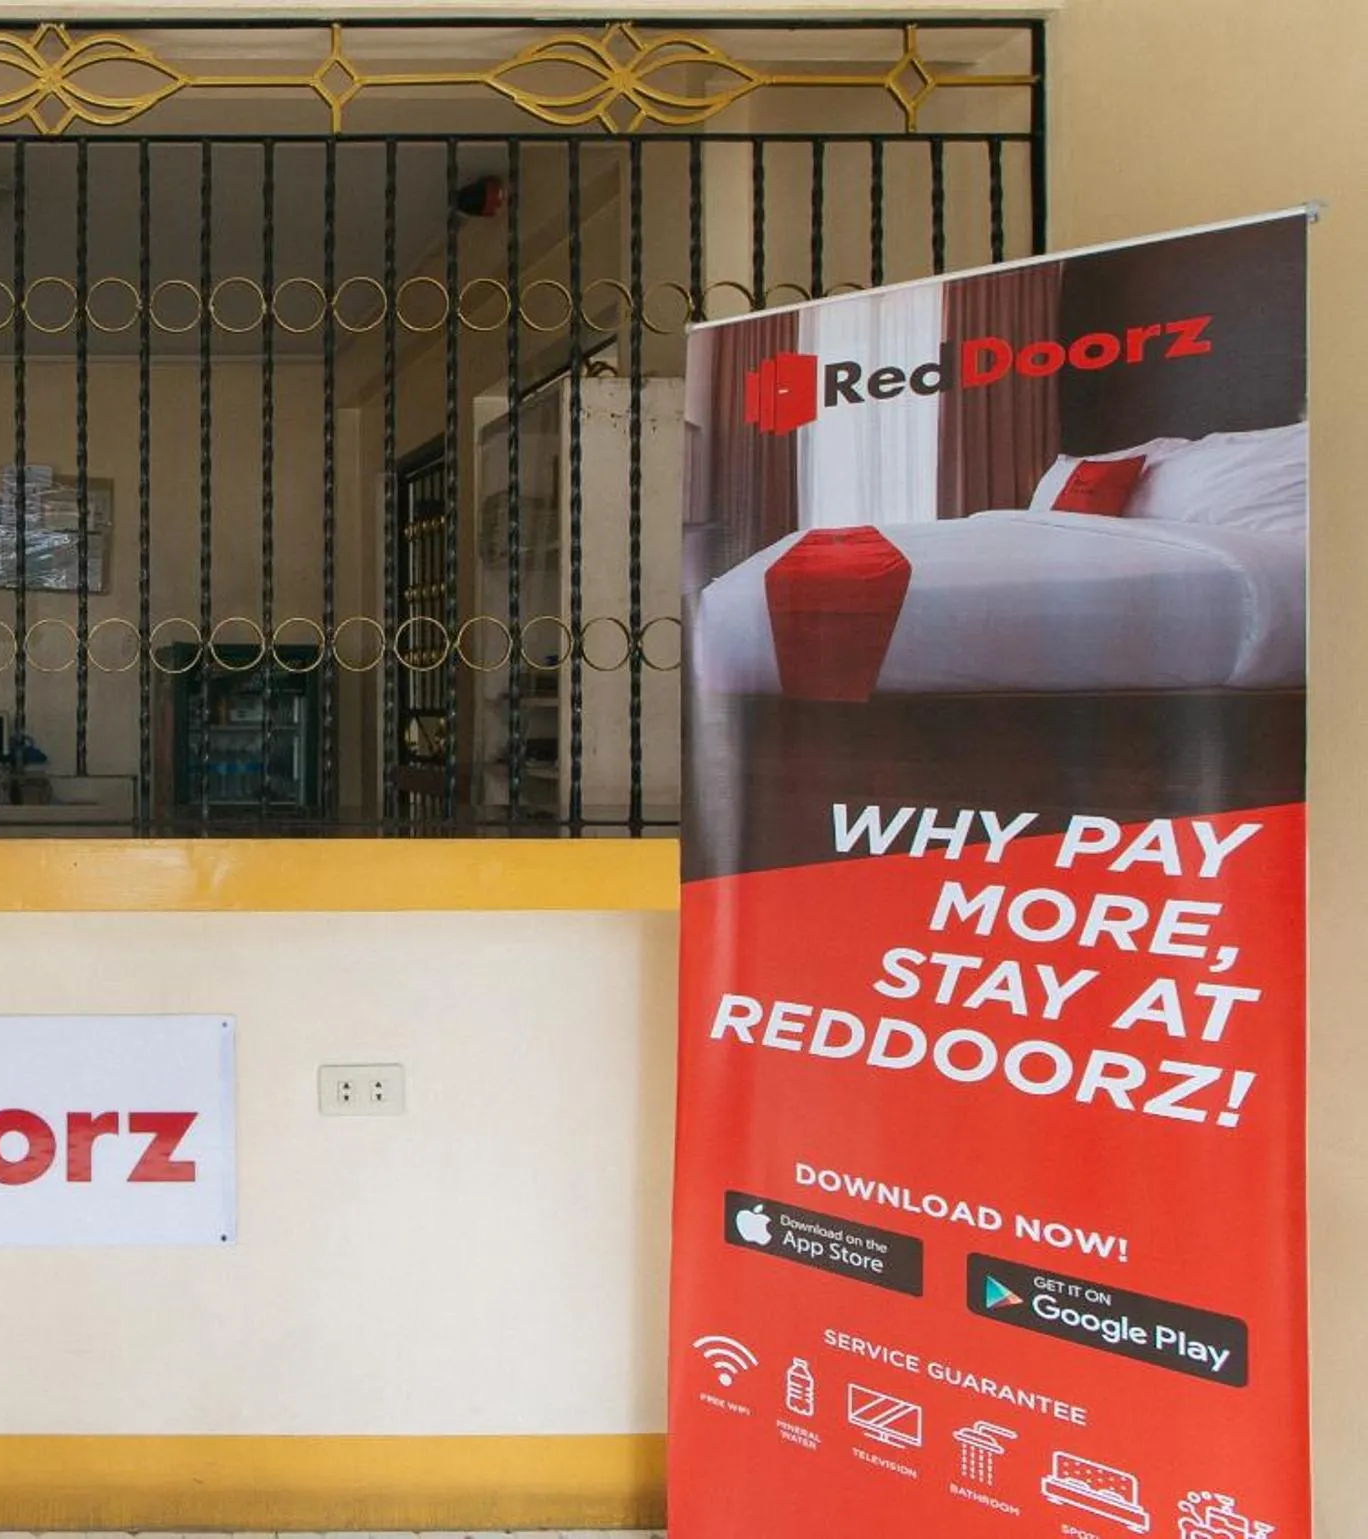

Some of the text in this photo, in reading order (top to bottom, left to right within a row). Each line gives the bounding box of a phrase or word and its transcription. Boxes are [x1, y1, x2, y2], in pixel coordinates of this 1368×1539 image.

[823, 314, 1213, 408] RedDoorz
[832, 803, 1262, 878] WHY PAY
[929, 881, 1240, 973] MORE,
[872, 947, 1260, 1043] STAY AT
[710, 994, 1257, 1129] REDDOORZ!
[780, 1213, 888, 1254] Download on the
[795, 1162, 1129, 1263] DOWNLOAD NOW!
[783, 1230, 885, 1274] App Store
[1033, 1275, 1112, 1306] GET IT ON
[1032, 1293, 1231, 1373] Google Play
[824, 1328, 1087, 1426] SERVICE GUARANTEE
[781, 1429, 818, 1450] WATER
[852, 1447, 918, 1479] TELEVISION
[949, 1482, 1021, 1516] BATHROOM
[1061, 1523, 1102, 1539] SPOT
